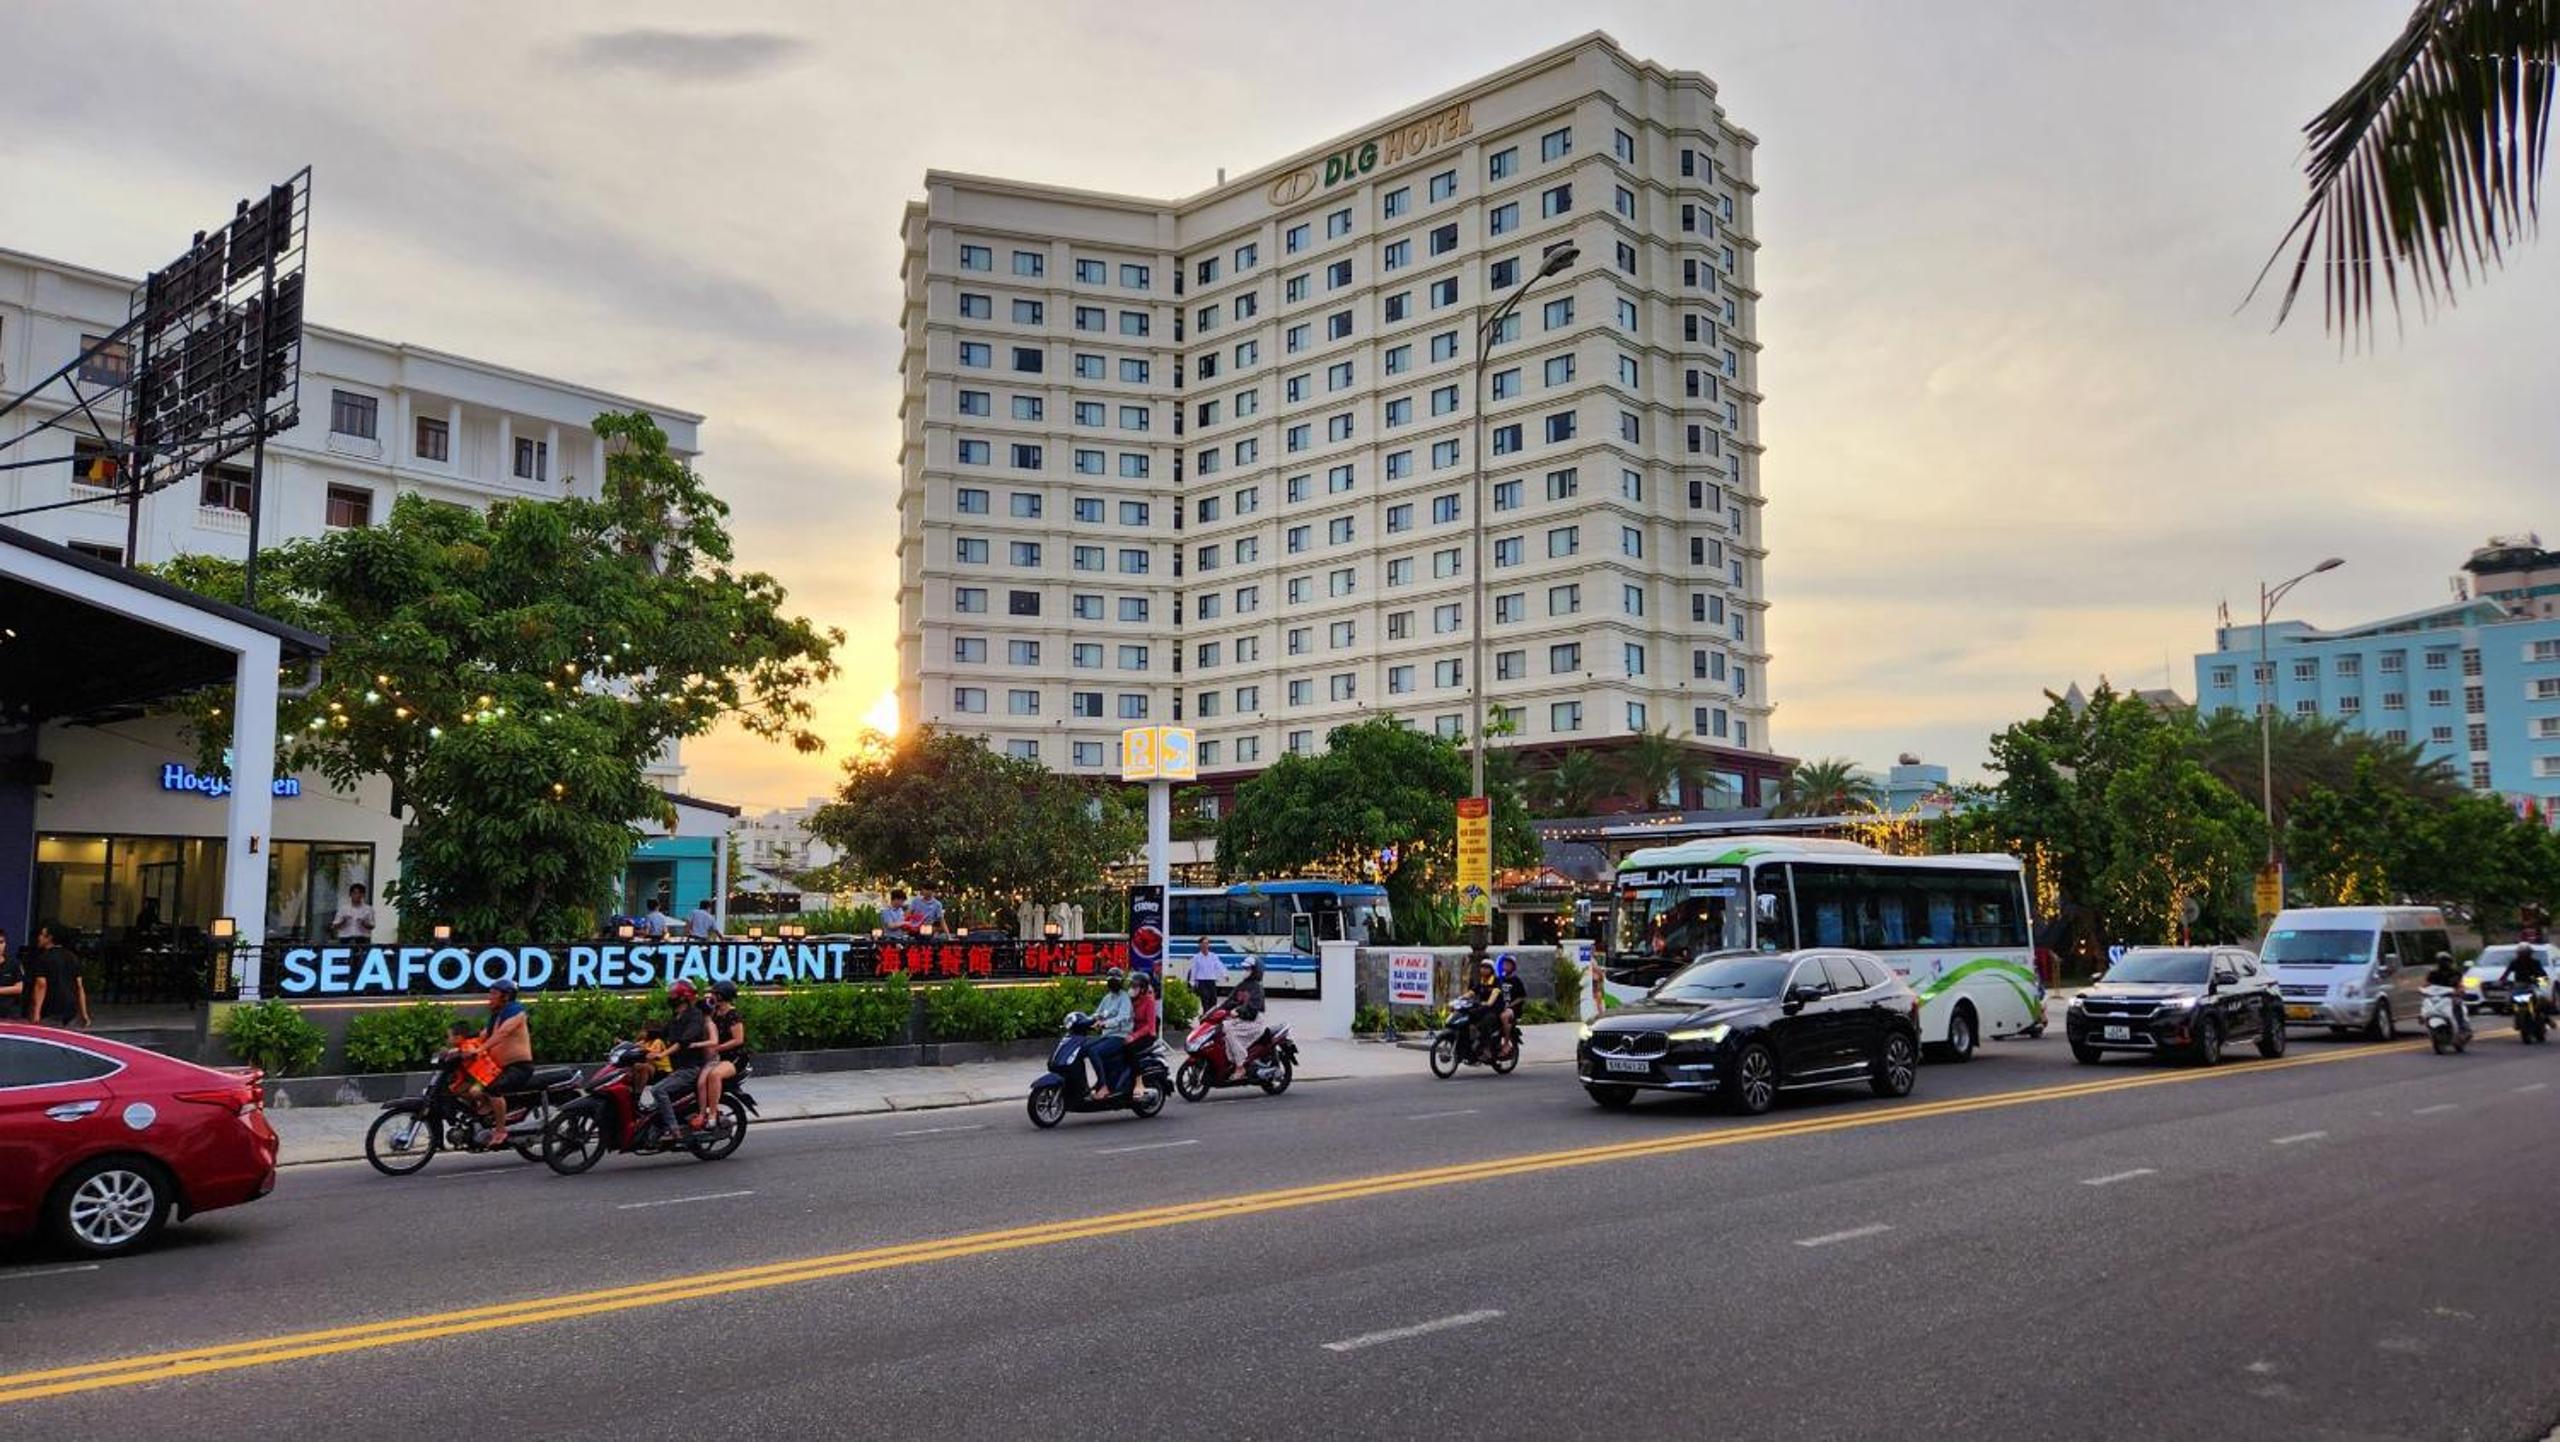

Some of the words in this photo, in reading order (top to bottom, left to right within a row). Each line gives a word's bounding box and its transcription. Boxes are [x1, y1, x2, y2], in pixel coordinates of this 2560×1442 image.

[1324, 142, 1378, 187] DLG
[1383, 103, 1473, 165] HOTEL
[280, 947, 553, 992] SEAFOOD
[568, 943, 851, 987] RESTAURANT
